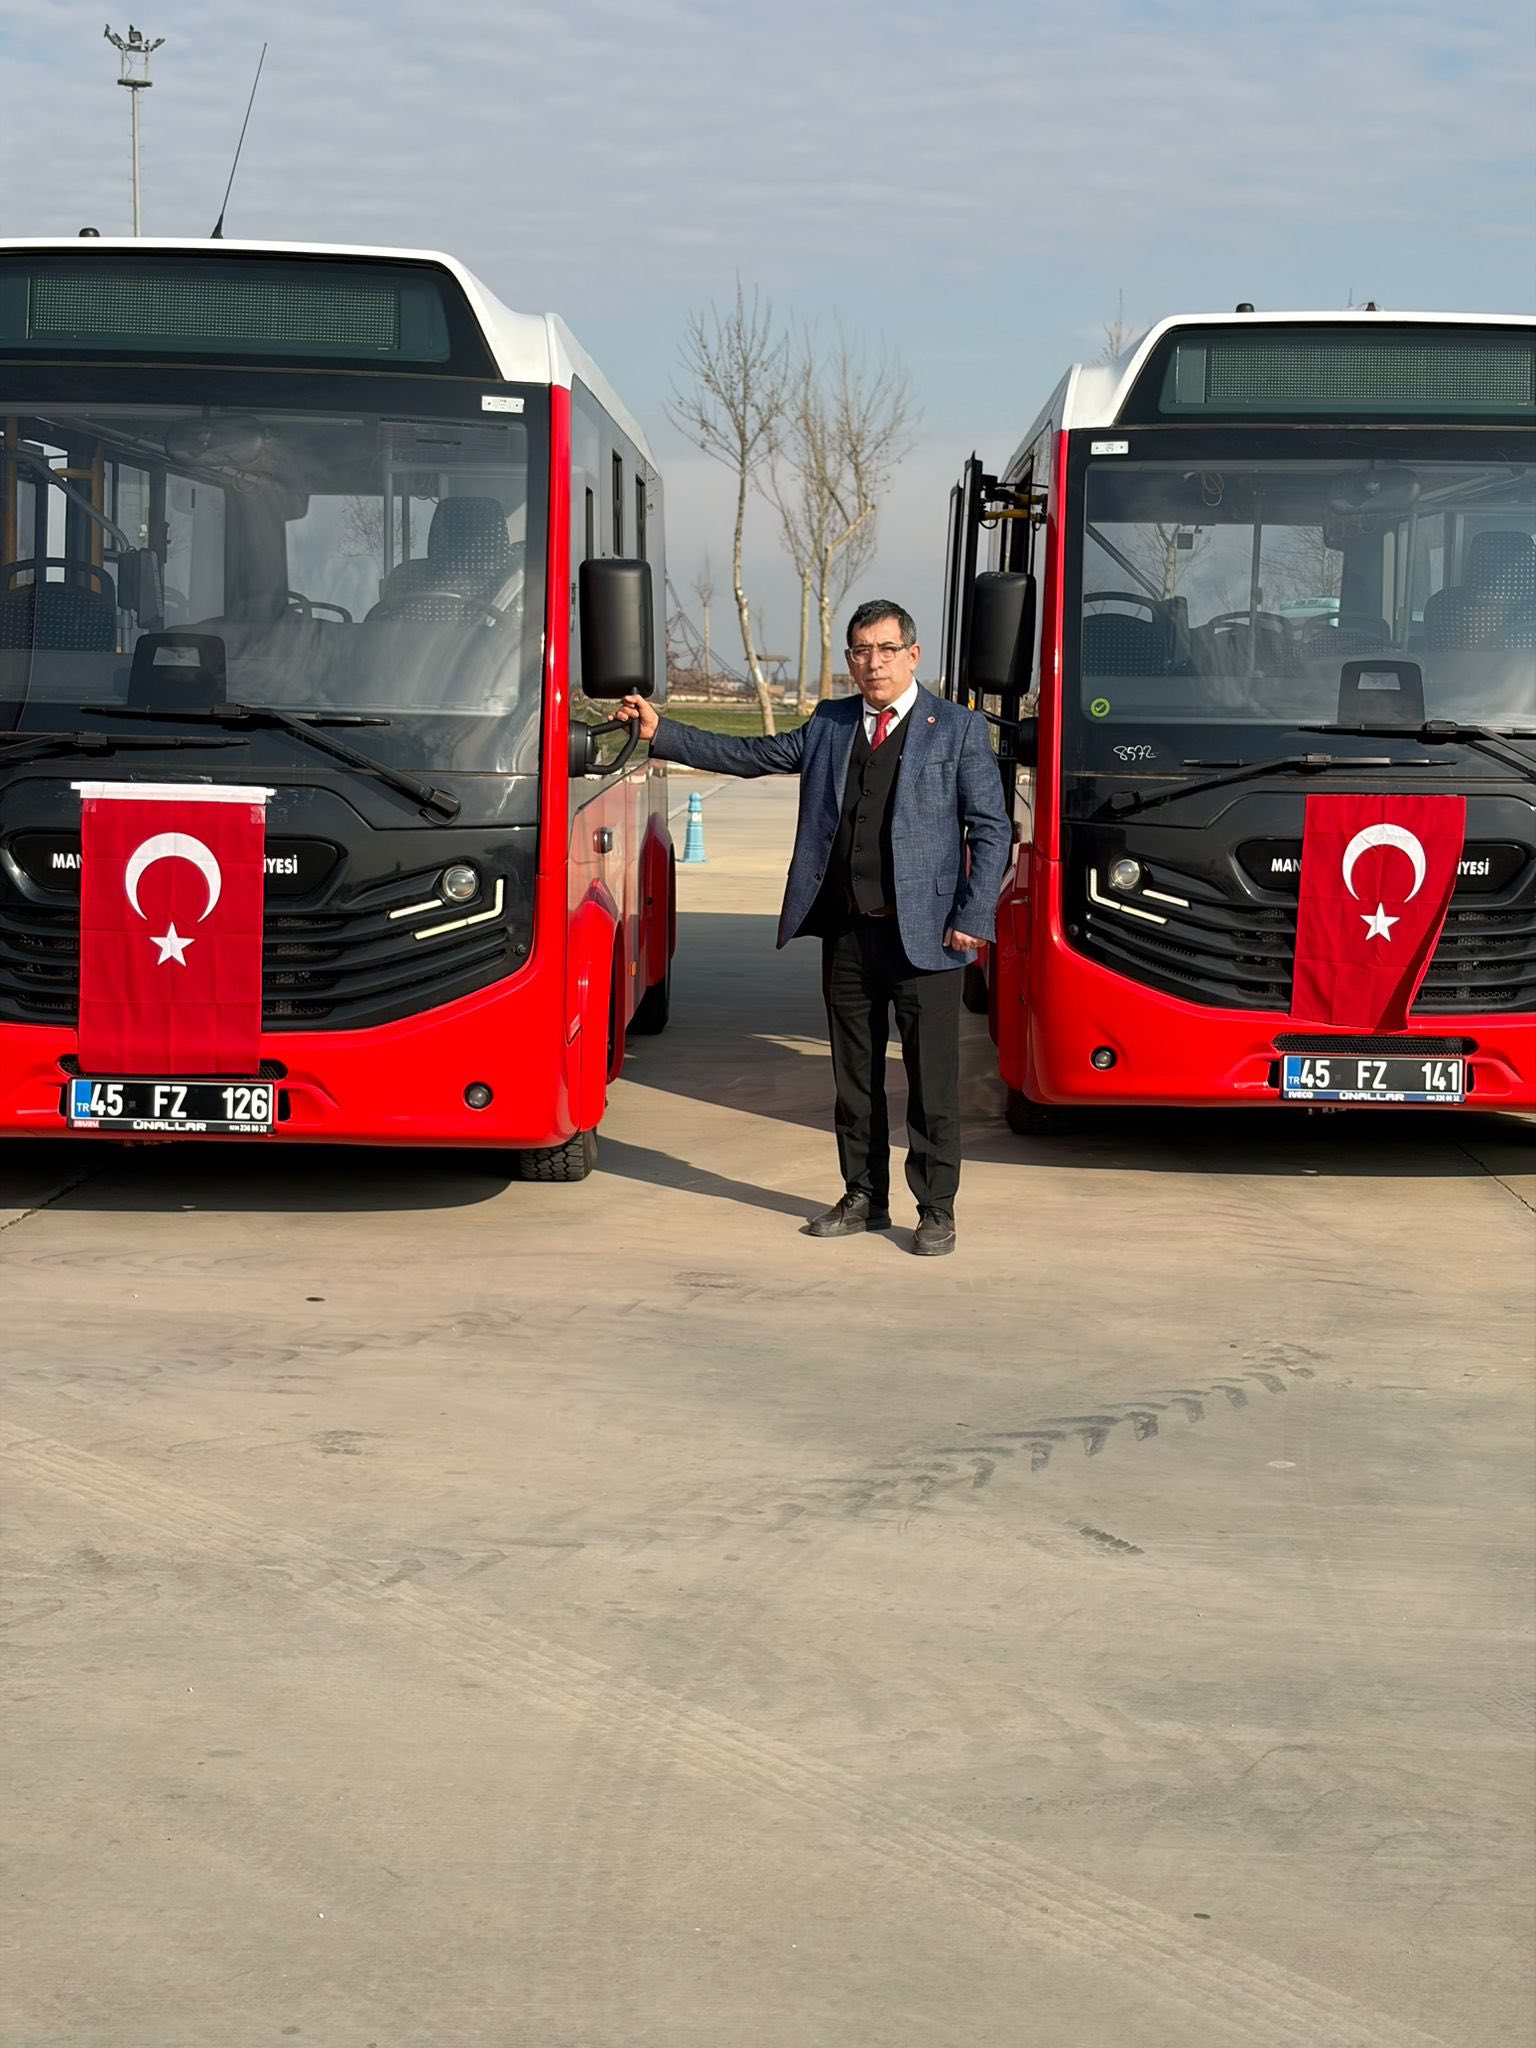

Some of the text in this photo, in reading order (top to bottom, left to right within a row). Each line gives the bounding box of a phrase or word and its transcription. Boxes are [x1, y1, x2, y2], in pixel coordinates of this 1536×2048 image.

[1288, 1059, 1458, 1091] TR 45 FZ 141
[76, 1083, 268, 1120] TR 45 FZ 126
[132, 1120, 207, 1132] ÜNALLAR
